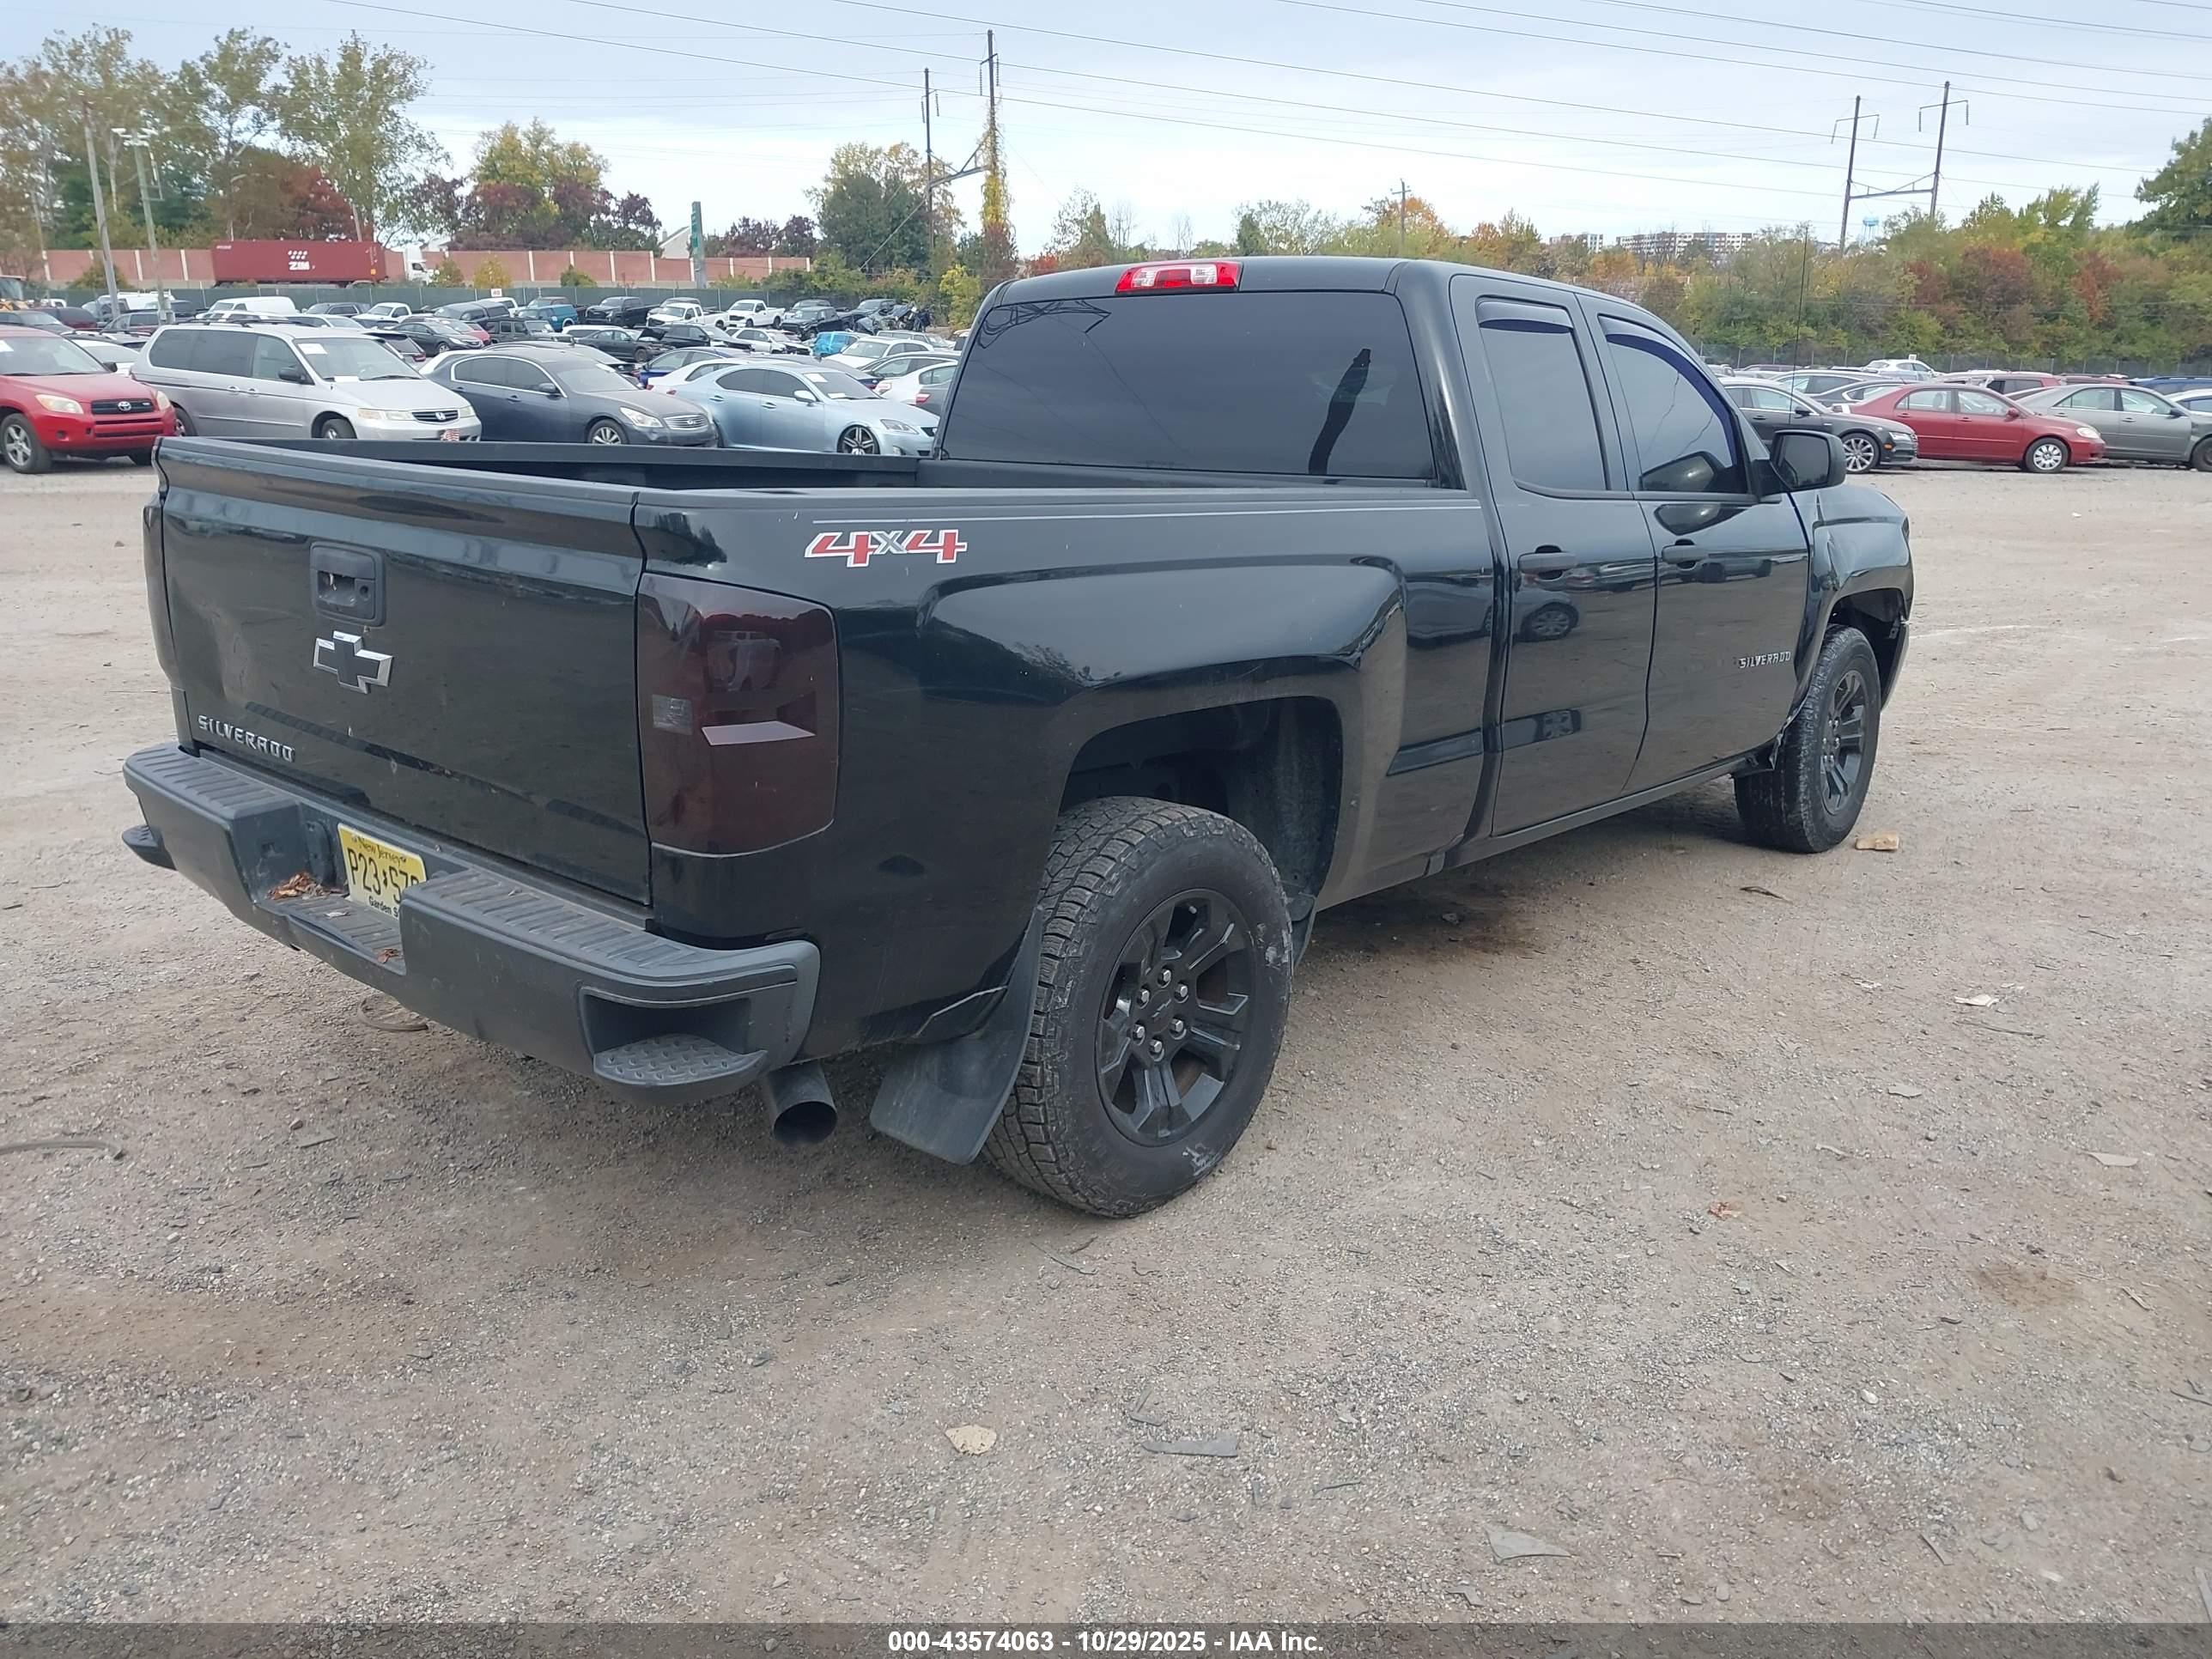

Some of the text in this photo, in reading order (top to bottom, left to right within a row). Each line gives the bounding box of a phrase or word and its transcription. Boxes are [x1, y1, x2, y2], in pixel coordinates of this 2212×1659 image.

[289, 261, 309, 270] ZIM
[1739, 651, 1791, 669] SILVERADO
[198, 714, 294, 763] SILVERADO
